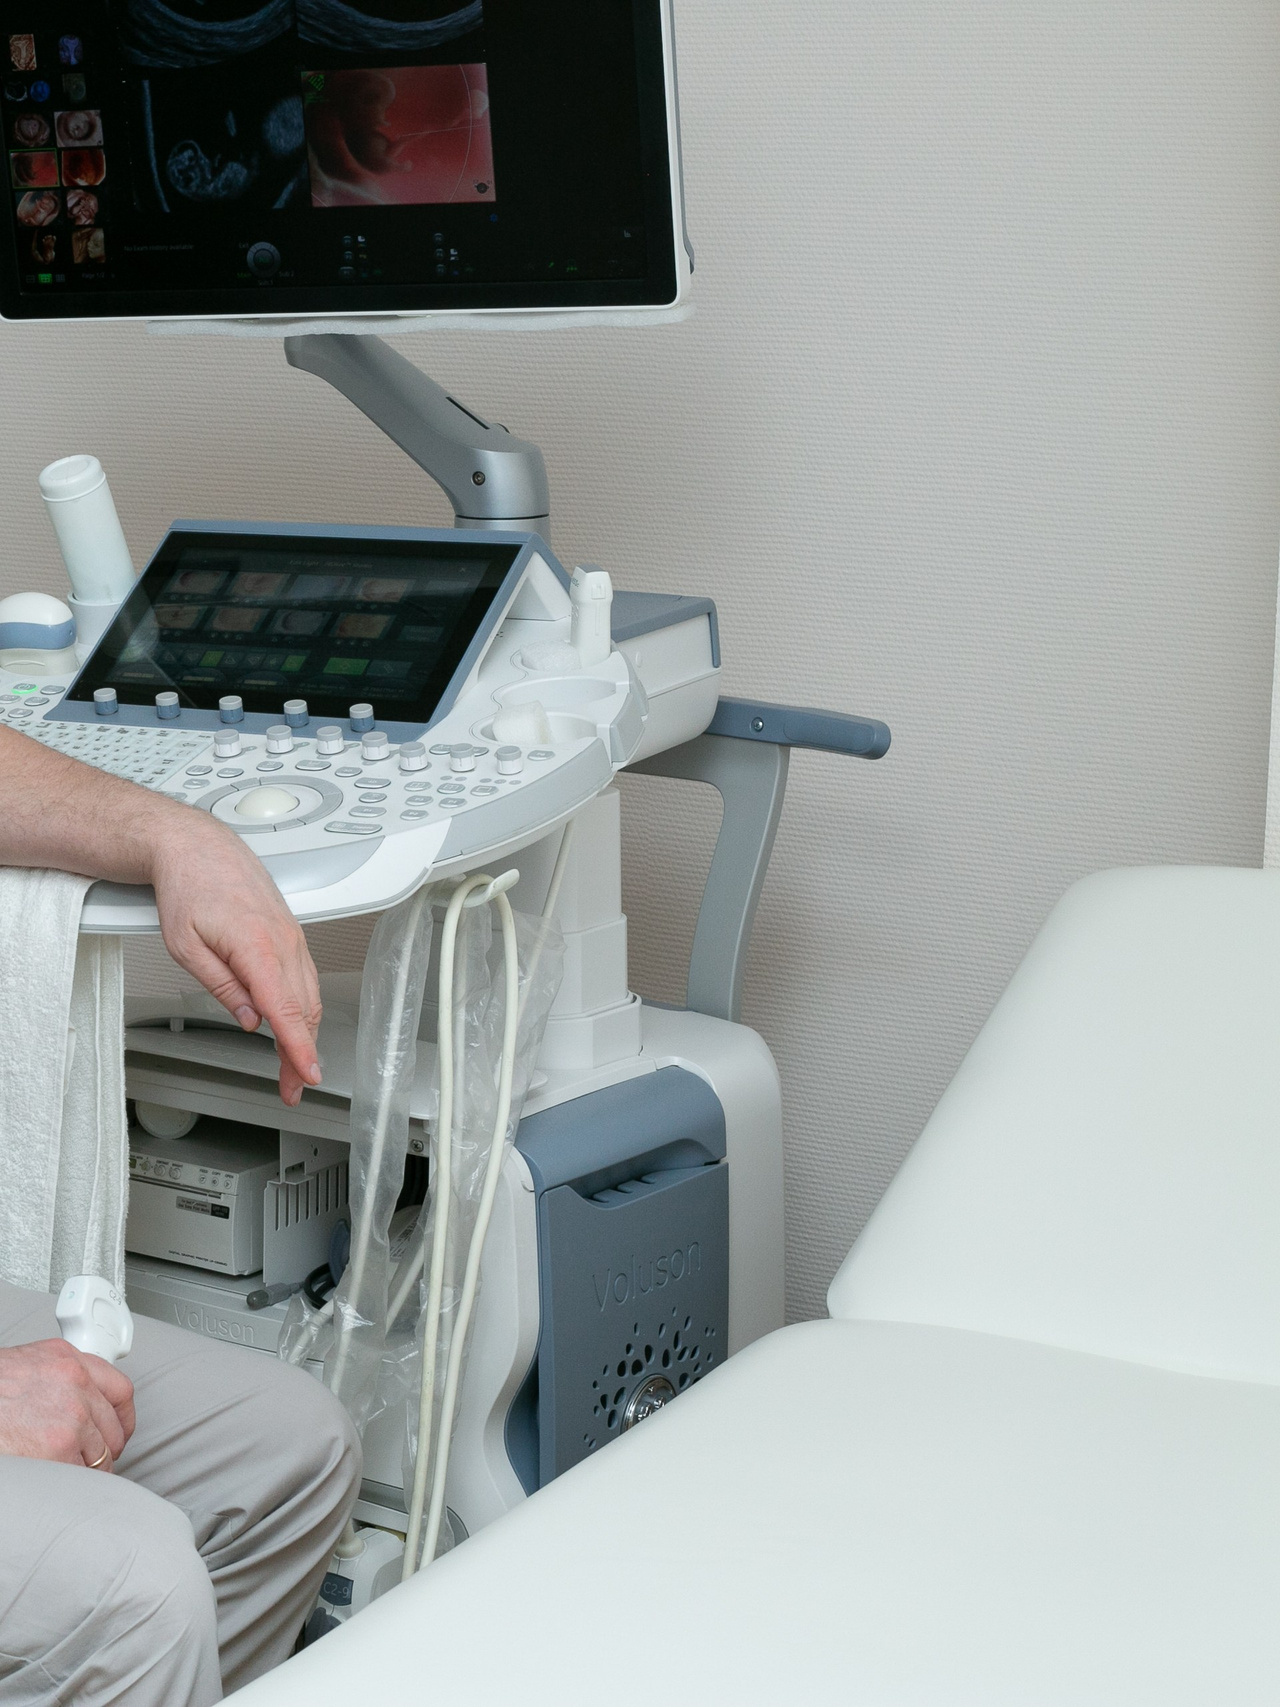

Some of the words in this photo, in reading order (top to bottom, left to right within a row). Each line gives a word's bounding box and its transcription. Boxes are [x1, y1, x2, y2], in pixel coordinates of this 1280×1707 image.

[592, 1241, 701, 1313] Voluson
[174, 1303, 255, 1344] Voluson
[323, 1581, 350, 1599] C2-9
